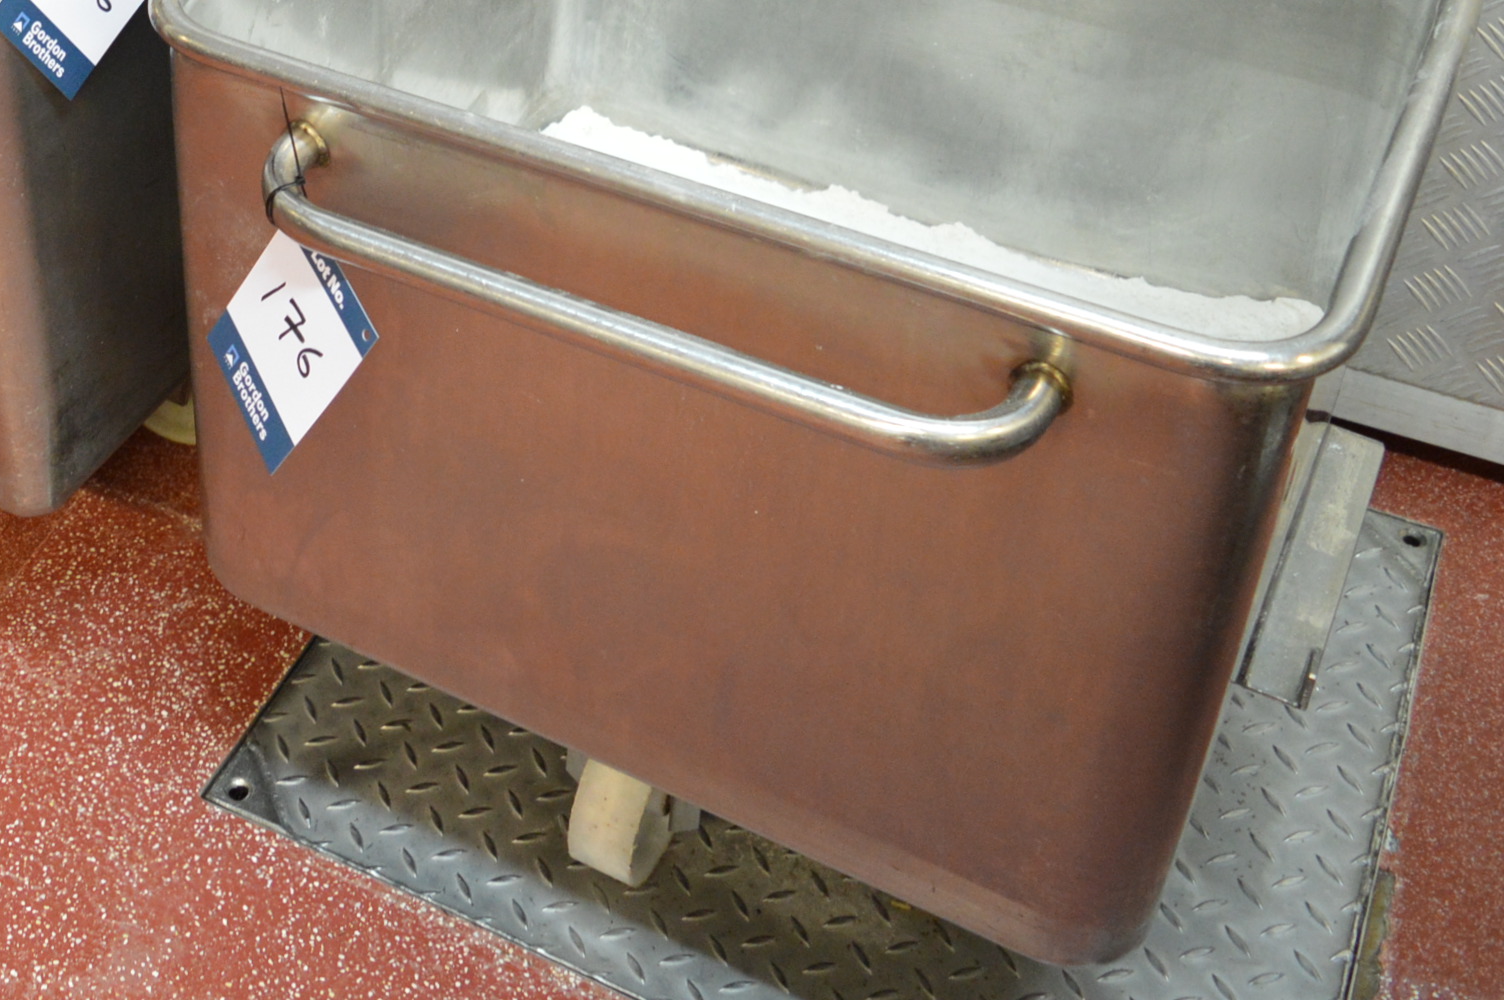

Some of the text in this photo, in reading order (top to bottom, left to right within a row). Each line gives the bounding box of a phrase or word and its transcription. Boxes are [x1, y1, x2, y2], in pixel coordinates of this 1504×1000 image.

[22, 32, 65, 78] Brothers
[29, 21, 67, 62] Gordon
[311, 251, 345, 310] Lot No.
[260, 281, 324, 378] 176
[232, 370, 268, 441] Brothers
[239, 361, 269, 422] Gordon
